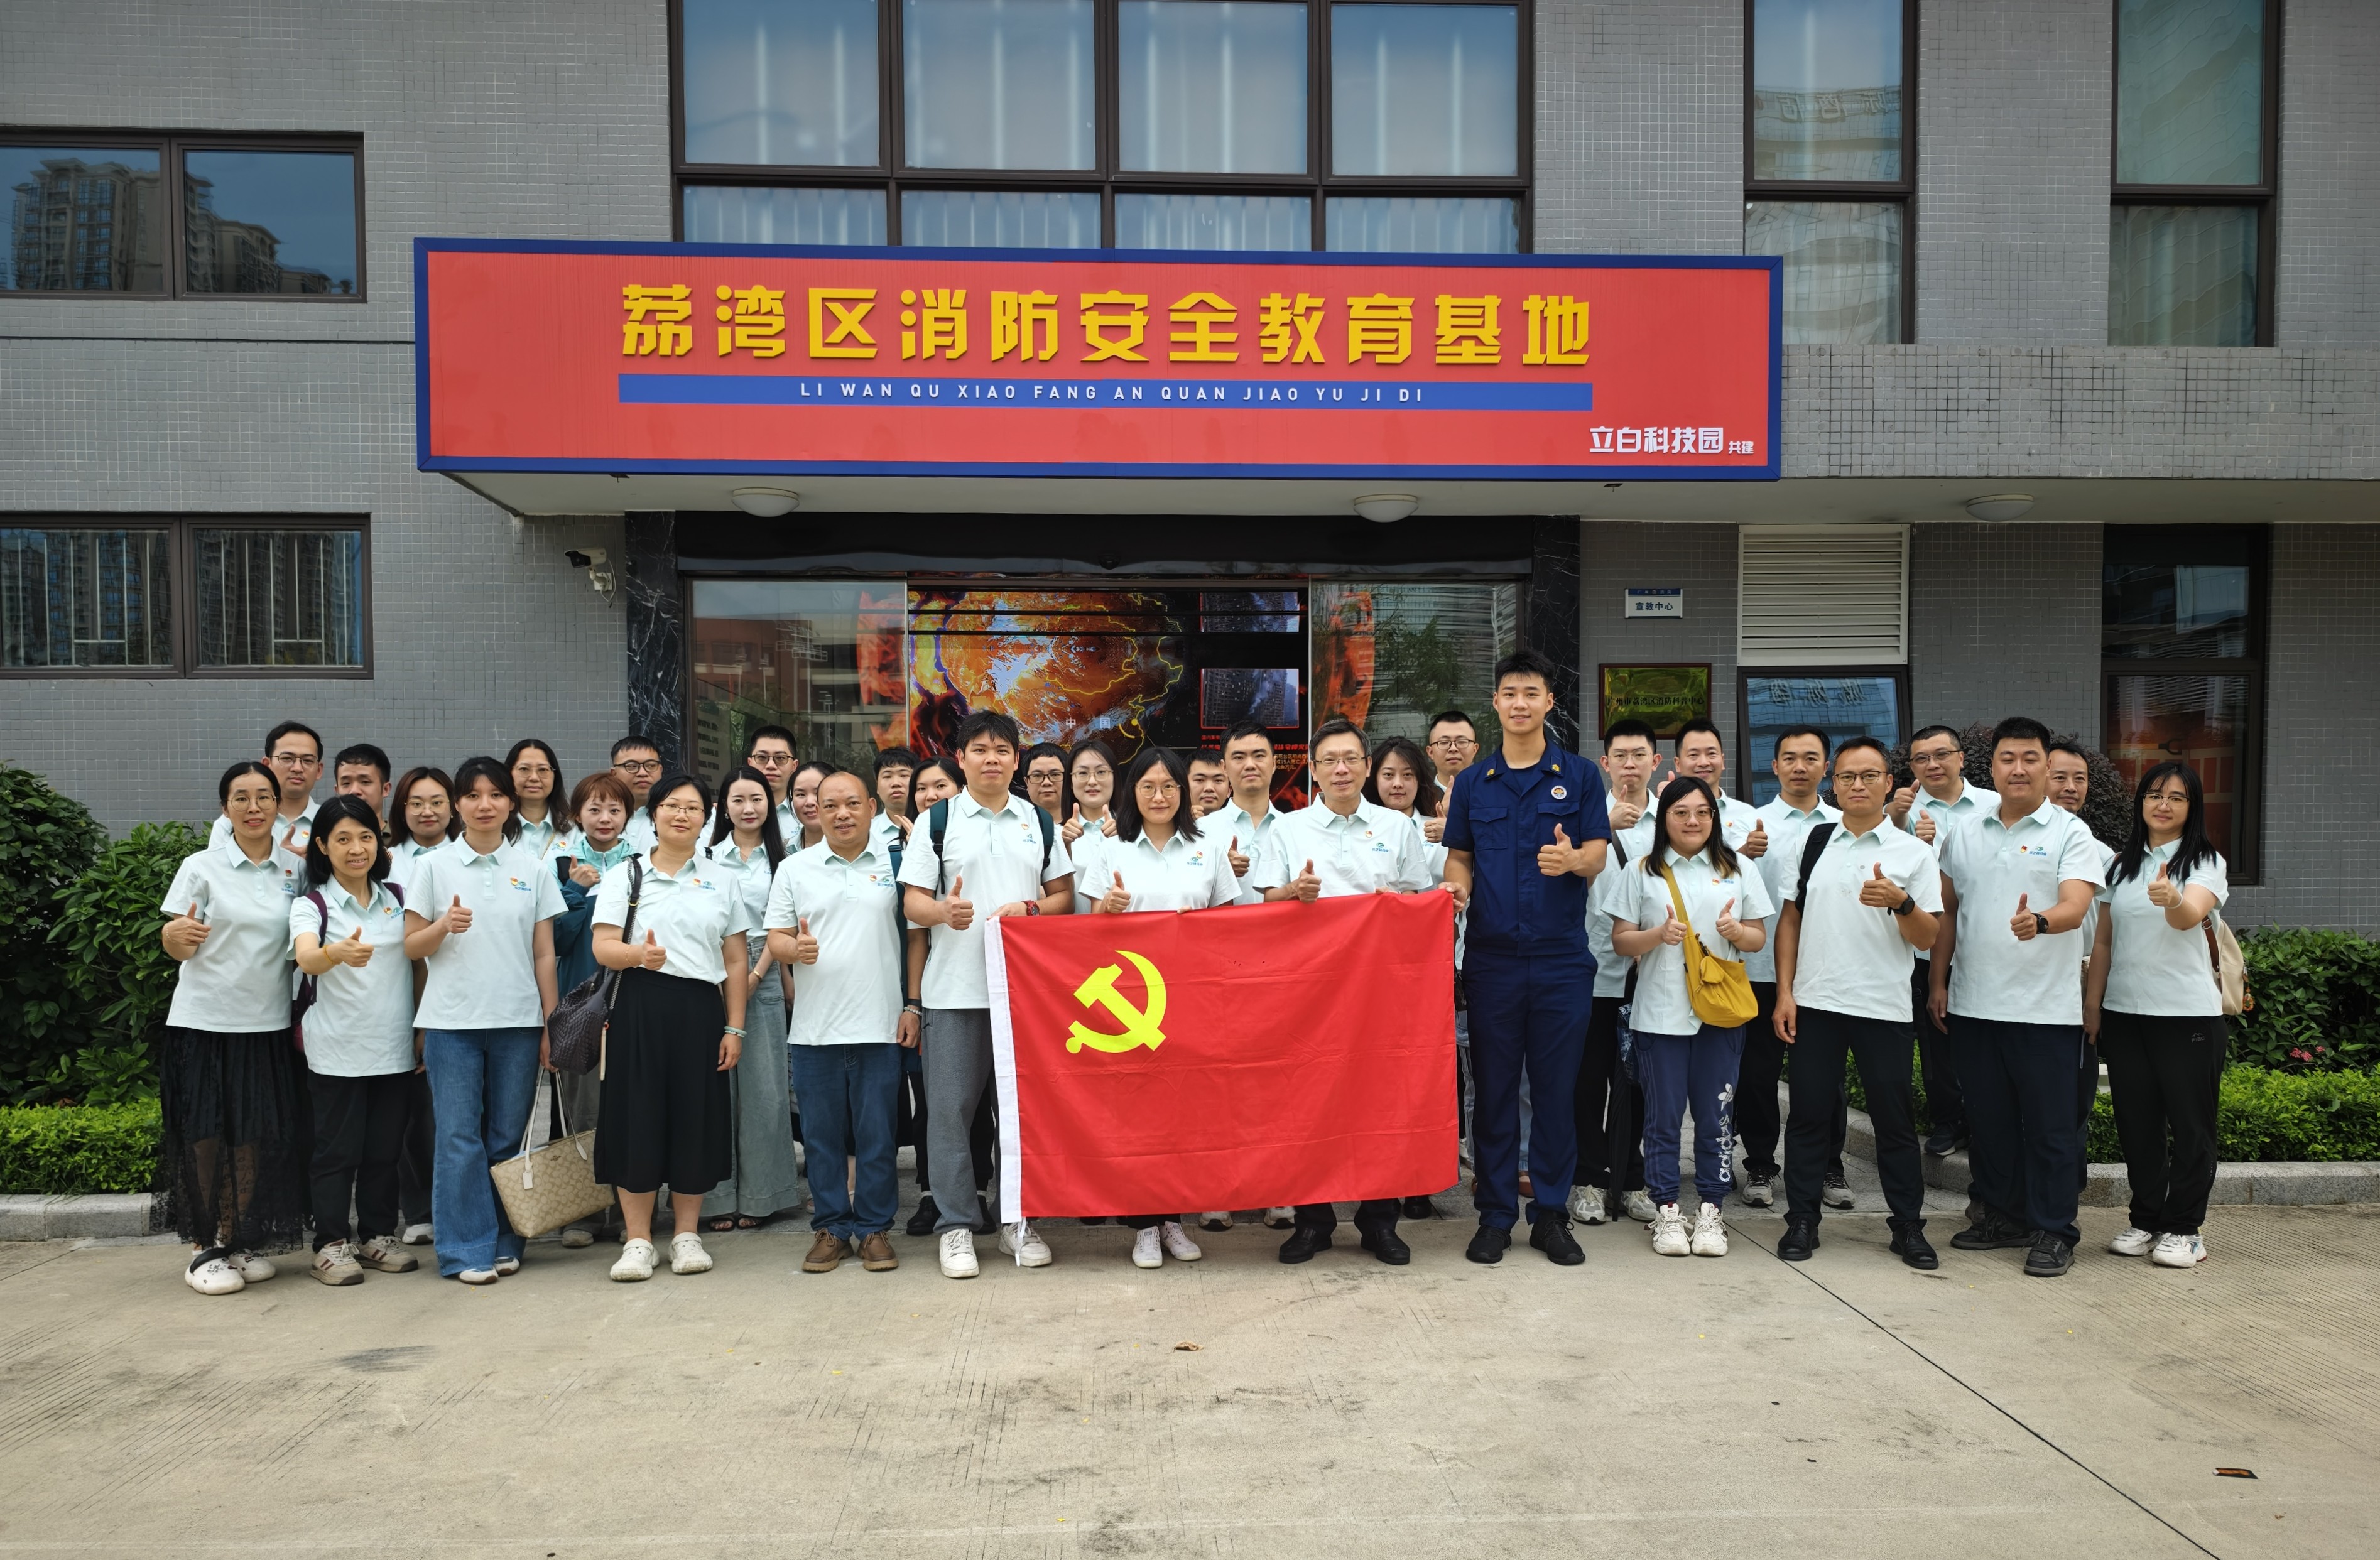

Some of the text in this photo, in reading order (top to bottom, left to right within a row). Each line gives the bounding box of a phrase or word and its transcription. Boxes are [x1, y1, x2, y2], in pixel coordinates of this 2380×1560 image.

[622, 284, 1590, 366] 荔湾区消防安全教育基地
[801, 383, 1421, 402] LI WAN QU XIAO FANG AN QUAN JIAO YU JI DI
[1589, 426, 1754, 455] 立白科技园 共建
[1635, 602, 1673, 611] 宣教中心
[1607, 696, 1705, 706] 广州市荔湾区消防科普中心
[1065, 717, 1111, 729] 中国
[1715, 1113, 1732, 1183] adidas
